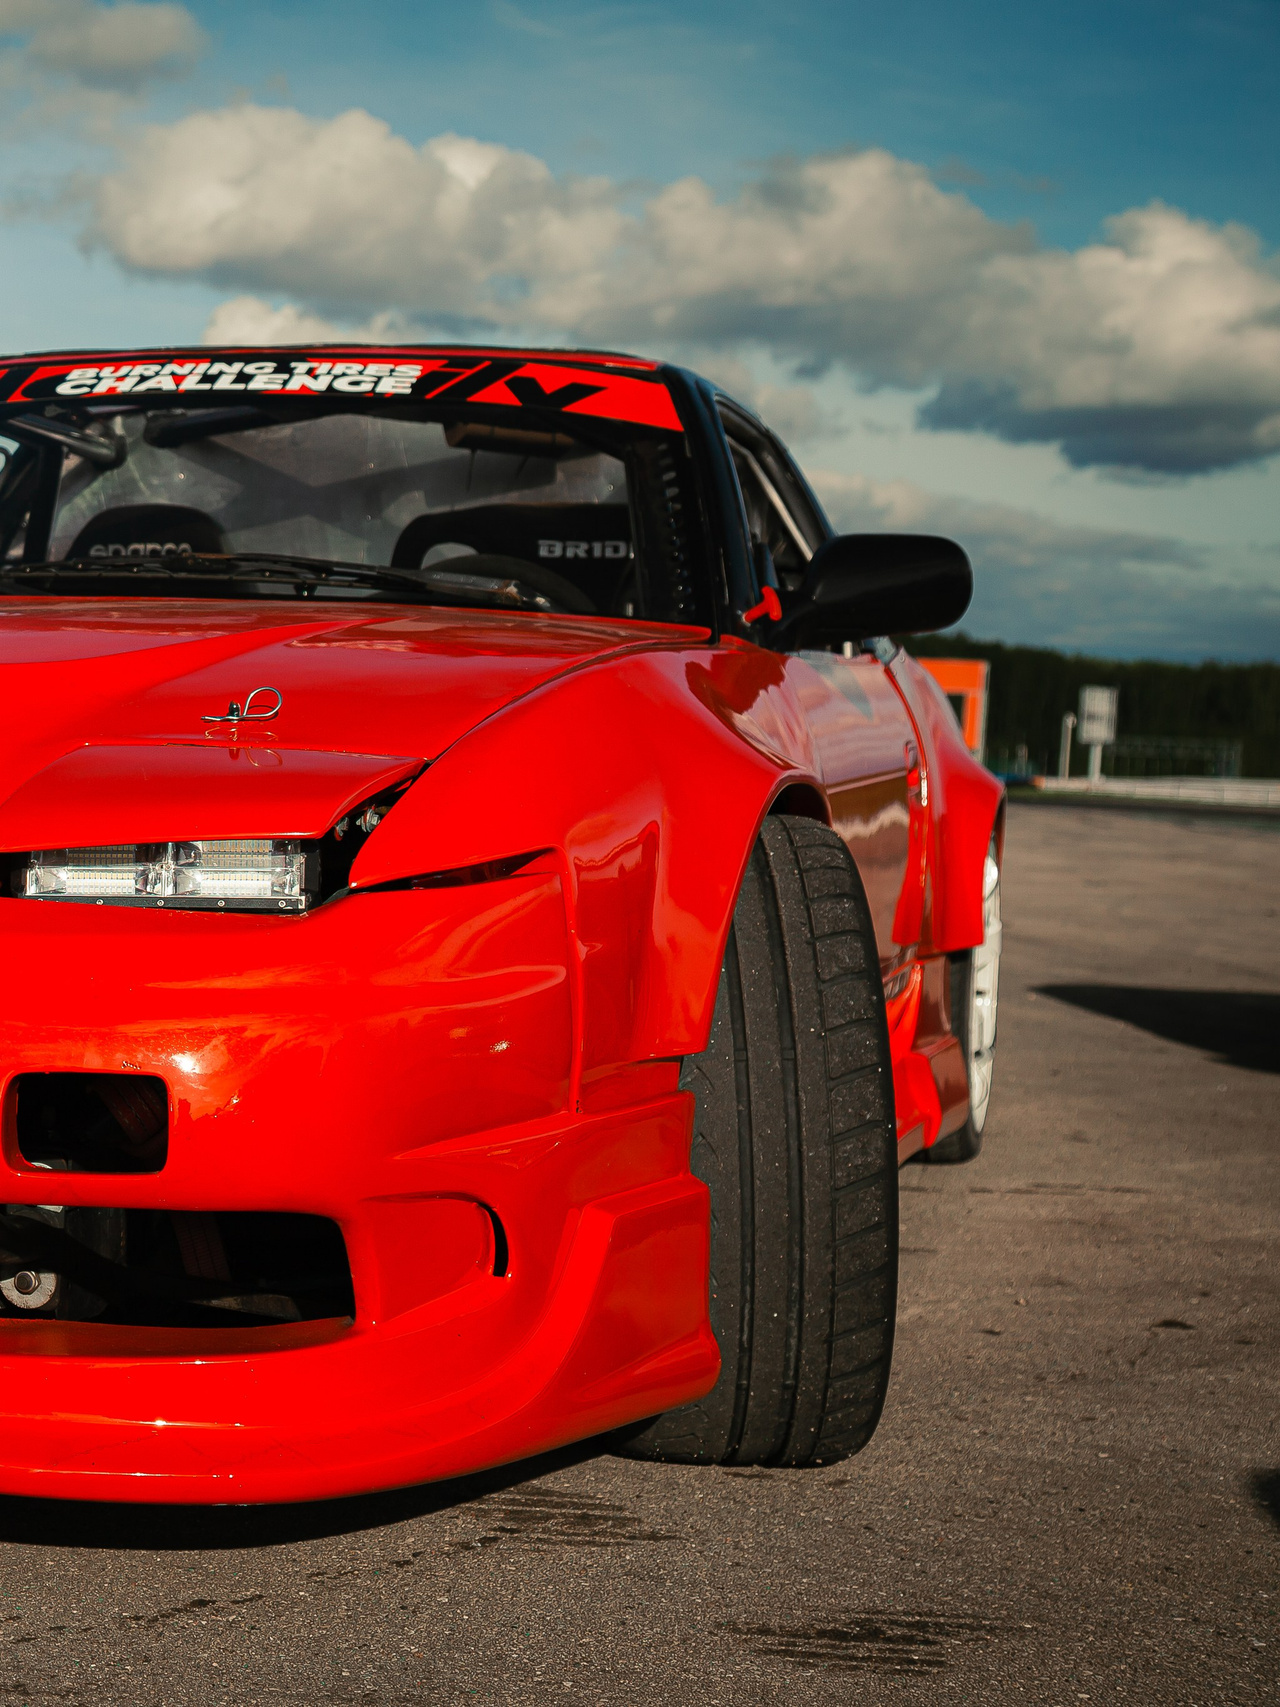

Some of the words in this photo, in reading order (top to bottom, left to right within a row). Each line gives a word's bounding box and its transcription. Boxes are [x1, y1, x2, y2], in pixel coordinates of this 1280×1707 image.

[65, 362, 277, 380] BURNING
[300, 362, 423, 377] TIRES
[55, 373, 417, 395] CHALLENGE
[538, 540, 627, 558] BRID
